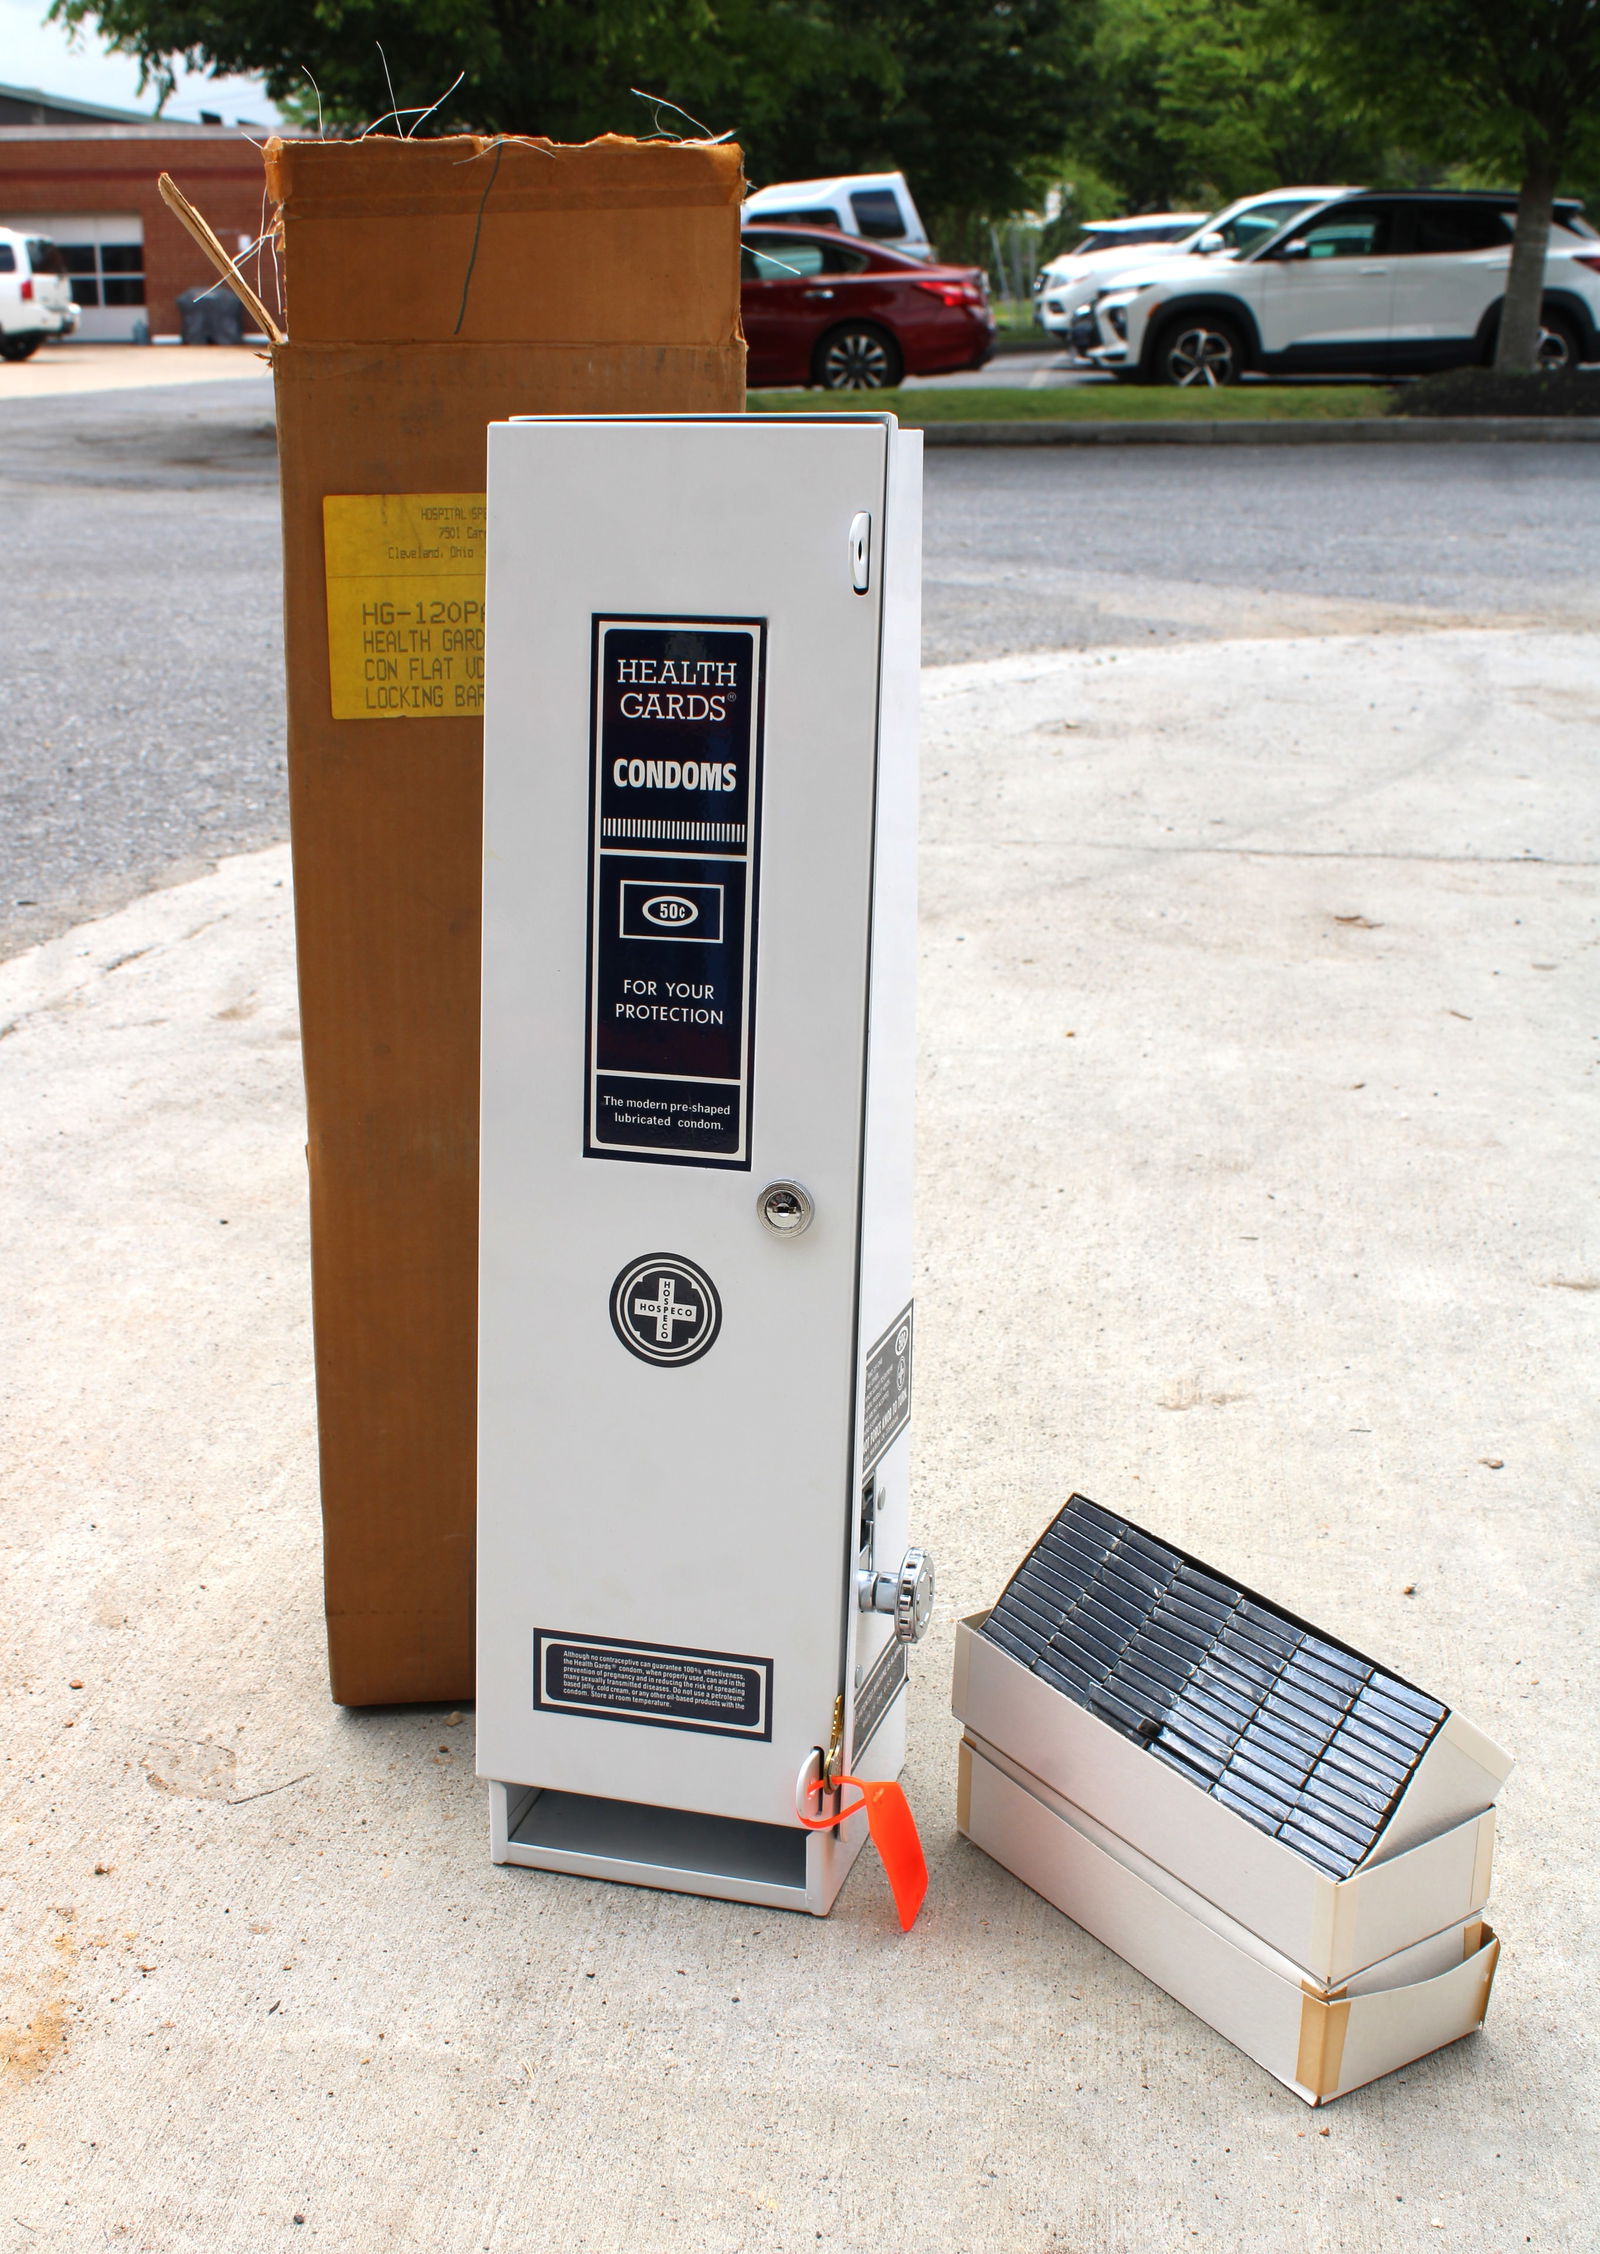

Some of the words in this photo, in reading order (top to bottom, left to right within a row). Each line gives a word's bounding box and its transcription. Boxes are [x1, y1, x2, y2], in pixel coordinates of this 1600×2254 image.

[421, 507, 467, 520] HOSPITAL
[439, 526, 460, 539] 7501
[467, 526, 486, 539] Car
[450, 546, 474, 558] Ohio
[363, 630, 430, 653] HEALTH
[364, 658, 398, 681] CON
[409, 657, 453, 680] FLAT
[617, 659, 737, 687] HEALTH
[366, 685, 443, 709] LOCKING
[613, 758, 737, 792] CONDOMS
[623, 979, 657, 996] FOR
[665, 982, 715, 1000] YOUR
[615, 1003, 724, 1025] PROTECTION
[603, 1095, 624, 1108] The
[626, 1098, 668, 1111] modern
[670, 1102, 731, 1116] pre-shaped
[614, 1112, 671, 1127] lubricated
[677, 1117, 724, 1131] condom.
[640, 1303, 693, 1317] HOSPECO
[563, 1650, 590, 1660] Although
[599, 1656, 639, 1667] contraceptive
[651, 1663, 682, 1672] guarantee
[683, 1666, 702, 1674] 100%
[563, 1666, 596, 1675] prevention
[603, 1670, 635, 1681] pregnancy
[655, 1677, 683, 1687] reducing
[683, 1680, 693, 1688] the
[694, 1682, 706, 1690] risk
[714, 1685, 746, 1696] spreading
[563, 1673, 580, 1681] many
[581, 1675, 606, 1685] sexually
[606, 1678, 641, 1688] transmitted
[672, 1686, 681, 1694] Do
[573, 1659, 593, 1667] Health
[645, 1668, 662, 1676] when
[662, 1671, 688, 1680] properly
[735, 1680, 746, 1688] the
[591, 1690, 607, 1699] Store
[597, 1684, 610, 1692] cold
[638, 1690, 650, 1698] any
[650, 1691, 666, 1699] other
[666, 1693, 694, 1703] oil-based
[694, 1697, 721, 1707] products
[721, 1701, 734, 1709] with
[734, 1702, 745, 1710] the
